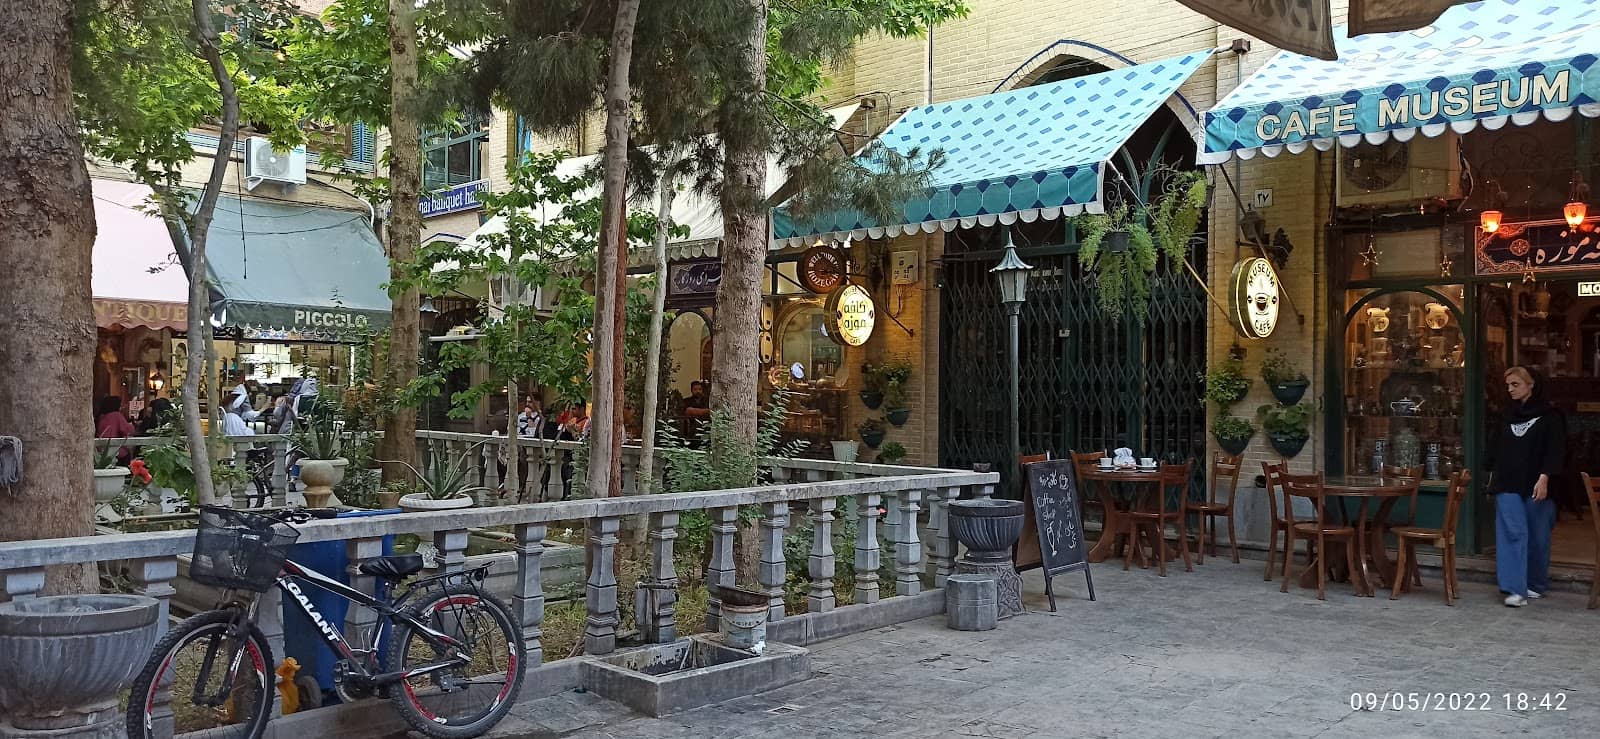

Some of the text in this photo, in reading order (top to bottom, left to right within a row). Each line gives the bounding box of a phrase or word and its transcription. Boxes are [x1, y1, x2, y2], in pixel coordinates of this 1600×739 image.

[1255, 70, 1571, 141] CAFE MUSEUM
[432, 192, 463, 212] banquet
[1248, 263, 1275, 288] MUSEUM
[844, 300, 866, 314] کافه
[294, 309, 368, 329] PICCOLO
[1255, 319, 1271, 333] CAFE
[288, 582, 340, 642] GALANT
